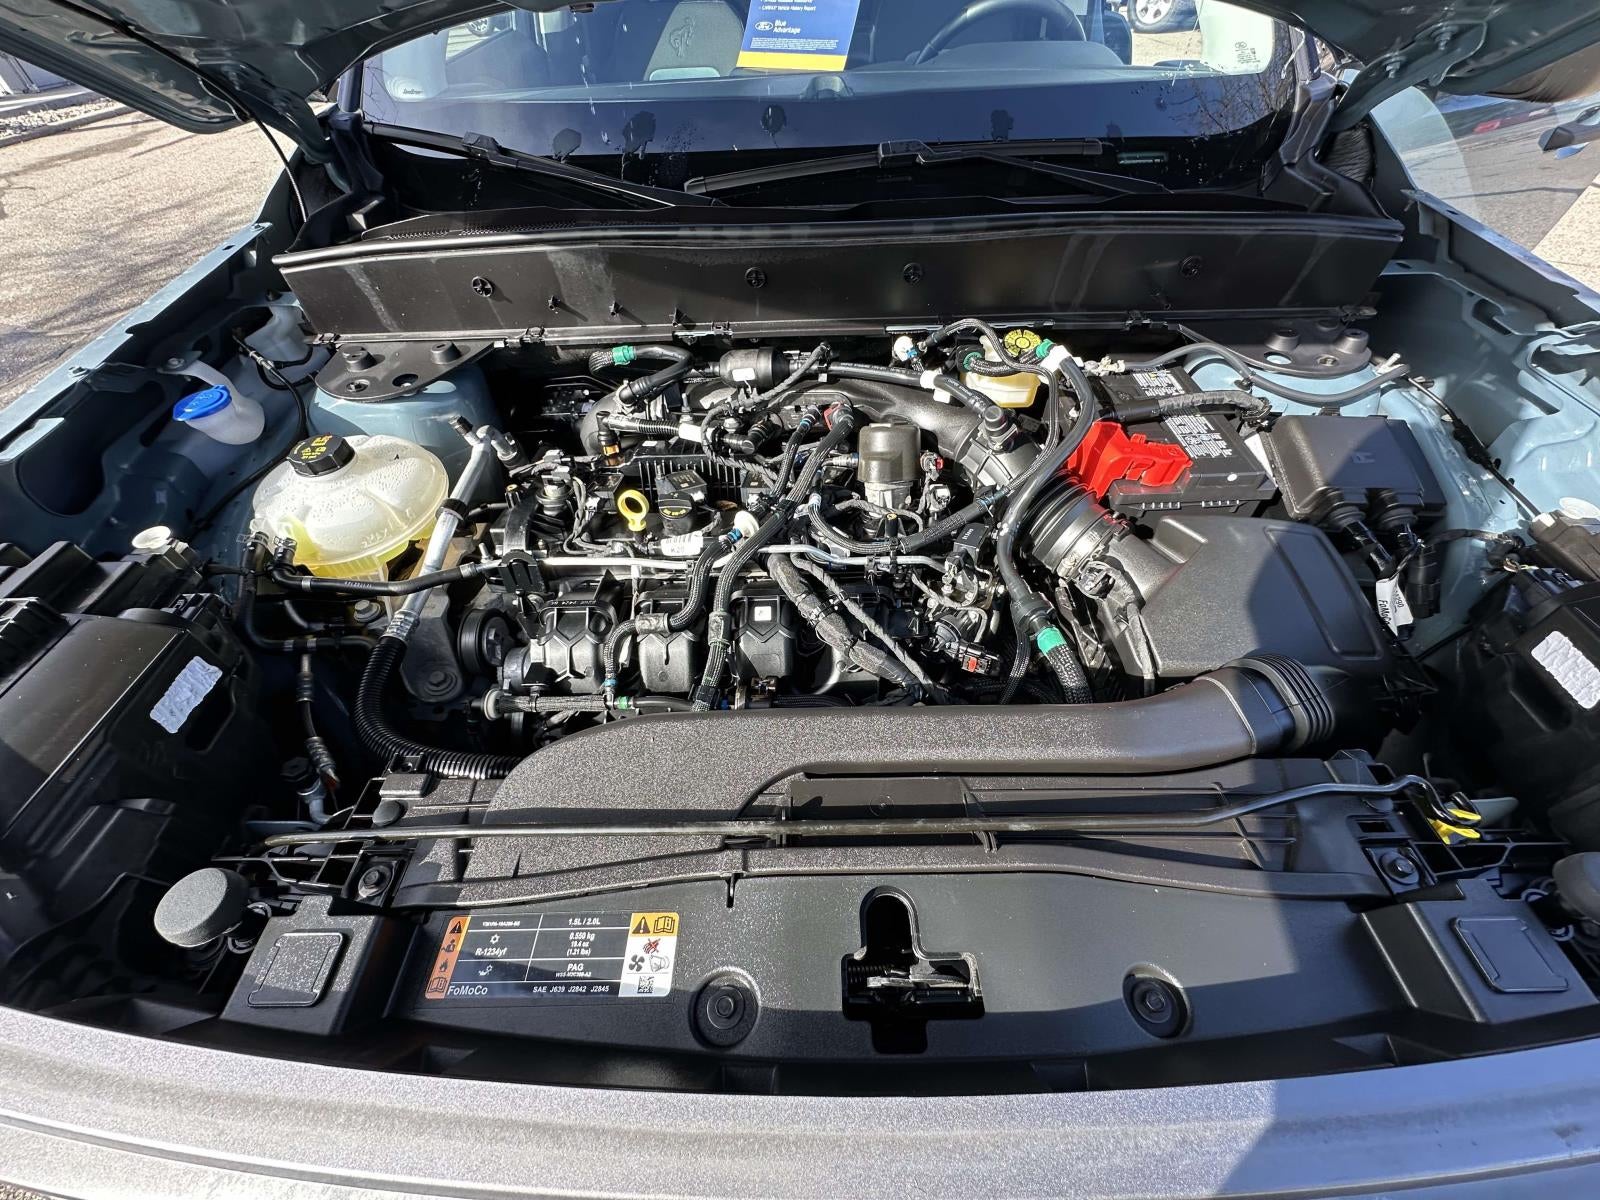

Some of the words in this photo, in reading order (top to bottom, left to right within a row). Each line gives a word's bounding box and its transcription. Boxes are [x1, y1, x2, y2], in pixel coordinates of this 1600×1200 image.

[568, 918, 582, 926] 1.5L
[586, 917, 601, 925] 2.0L
[586, 932, 596, 942] kg
[475, 947, 507, 957] R-1234yf
[567, 963, 585, 972] PAG
[447, 985, 488, 996] FoMoCo
[568, 985, 587, 993] J2842
[590, 985, 610, 993] J2845
